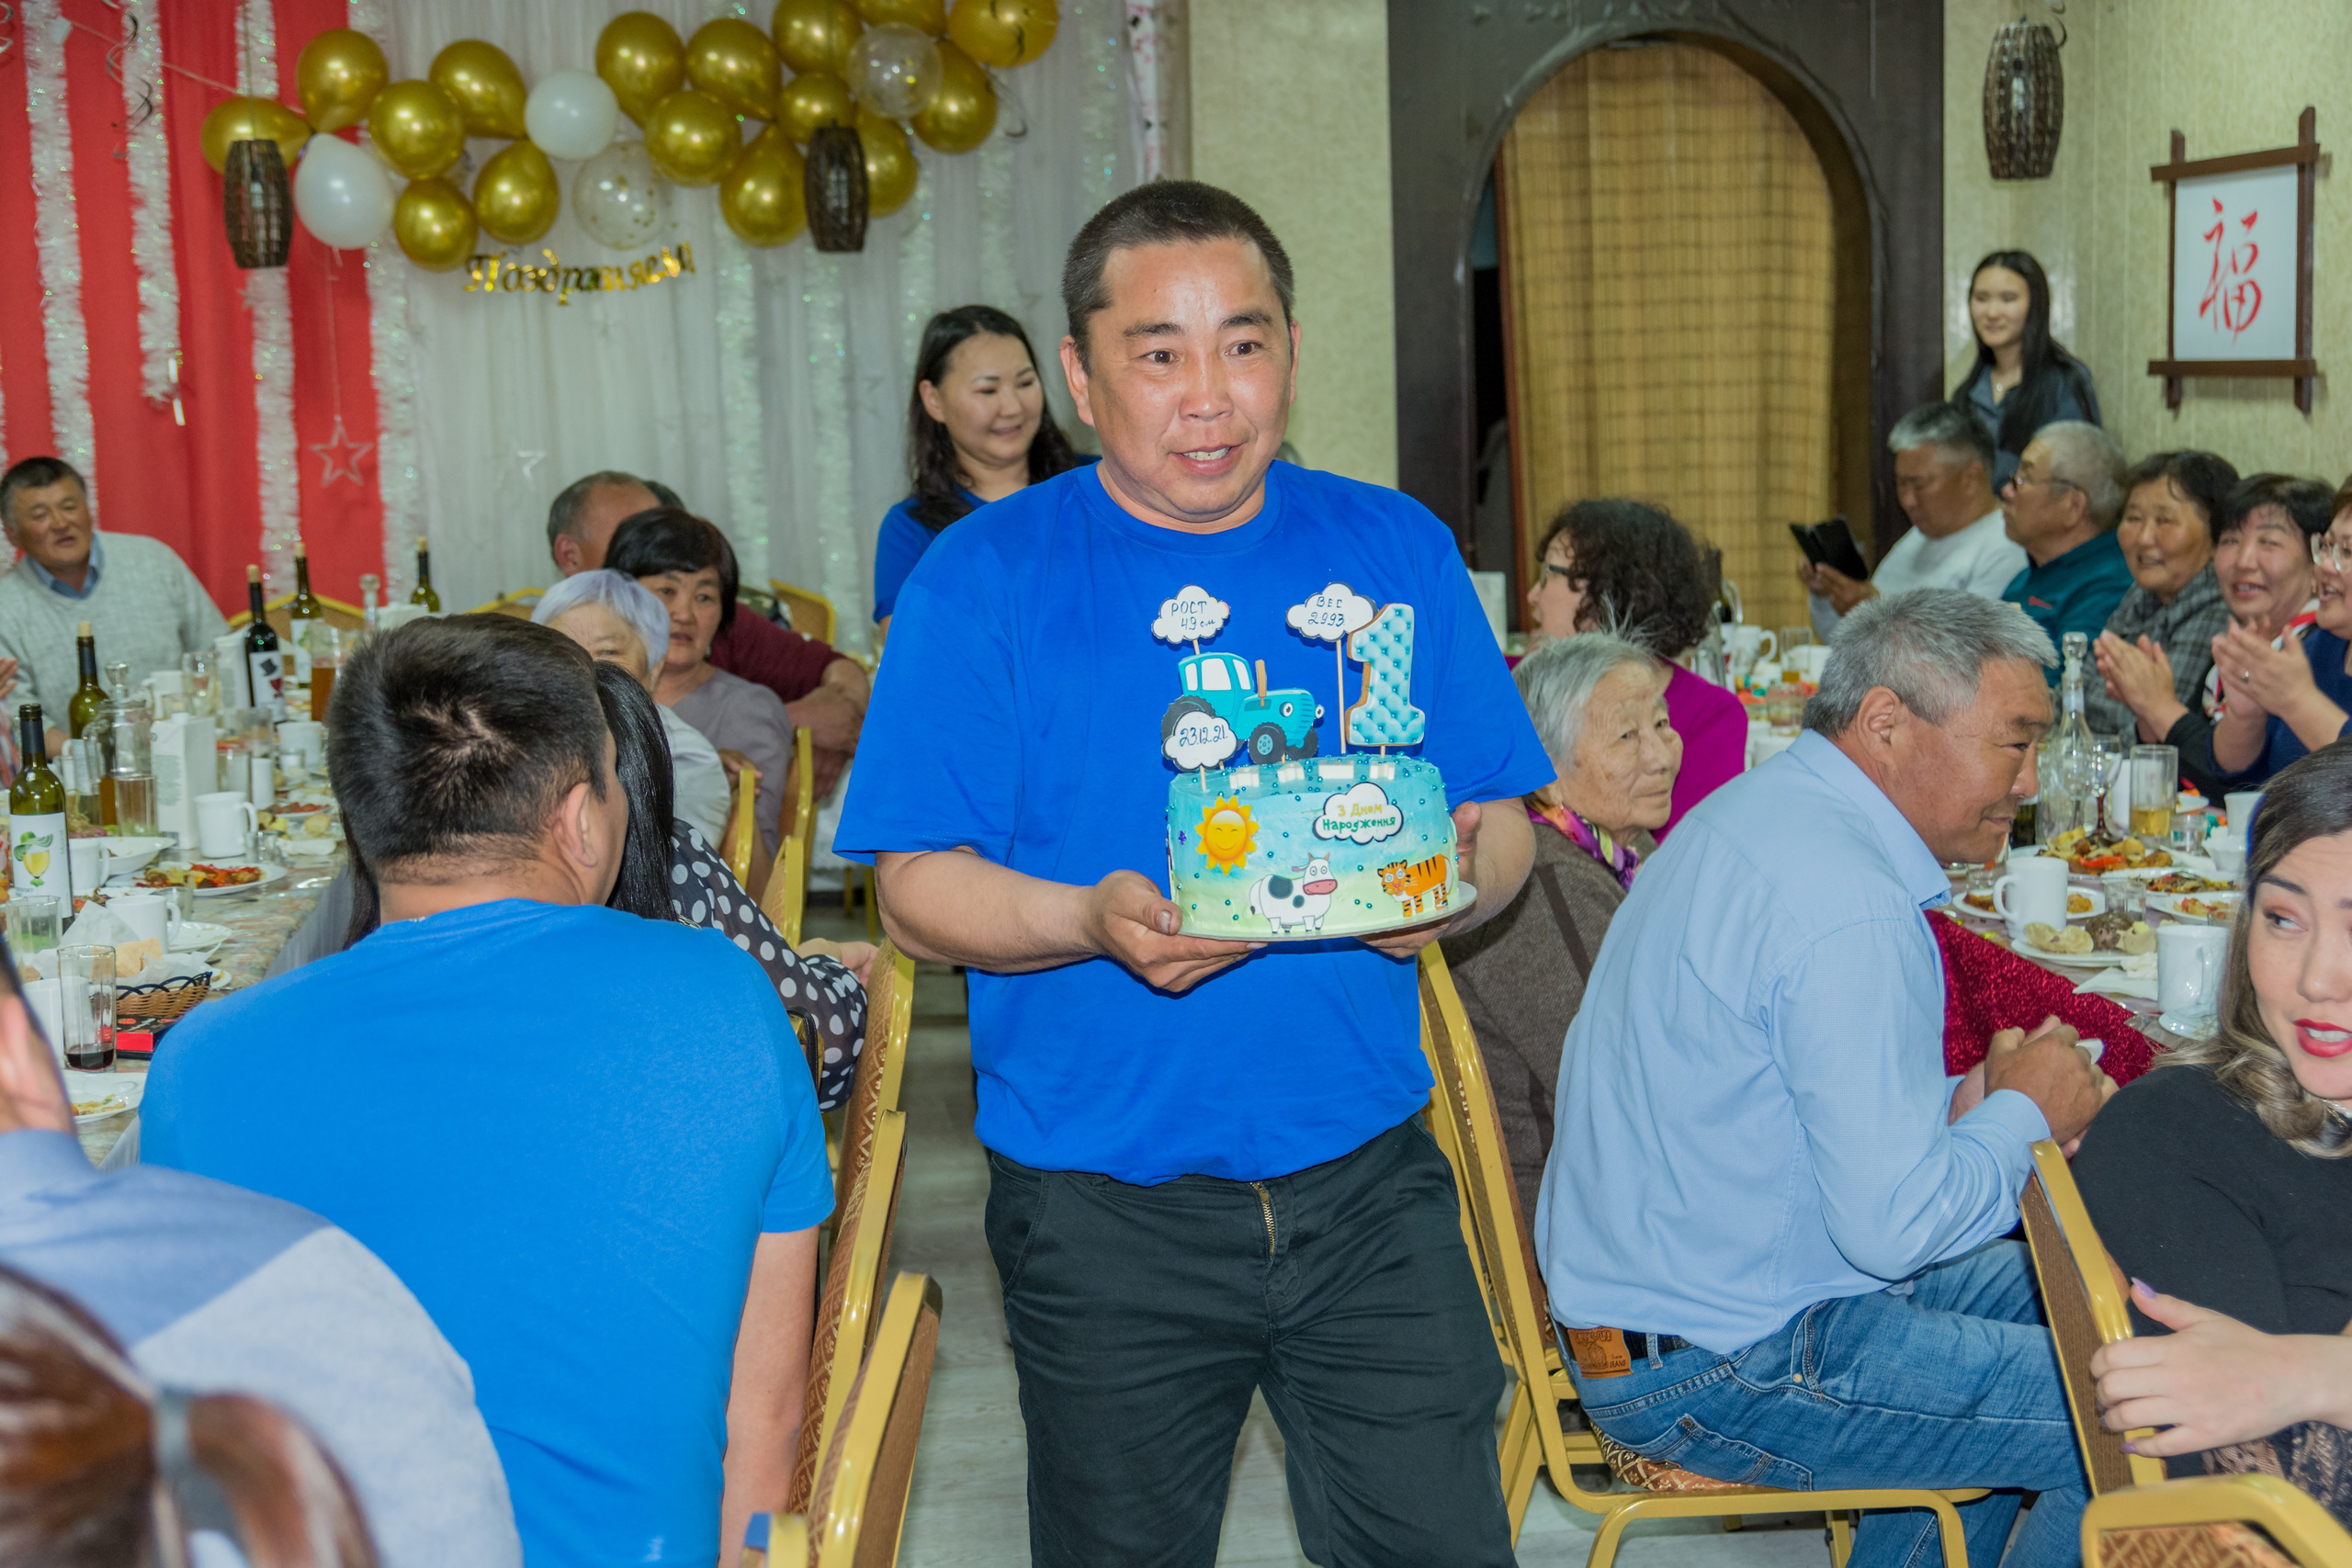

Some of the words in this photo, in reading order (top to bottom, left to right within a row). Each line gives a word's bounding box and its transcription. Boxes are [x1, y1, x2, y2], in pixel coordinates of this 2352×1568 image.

[2199, 196, 2262, 347] 福
[1171, 601, 1207, 616] РОСТ
[1317, 596, 1342, 608] ВЕС
[1181, 616, 1197, 631] 49
[1199, 619, 1216, 627] см
[1307, 612, 1345, 627] 2993
[1346, 603, 1426, 747] 1
[1337, 805, 1346, 817] З
[1351, 803, 1383, 818] Днем
[1322, 817, 1396, 834] Народження
[1610, 1359, 1626, 1369] JEANS
